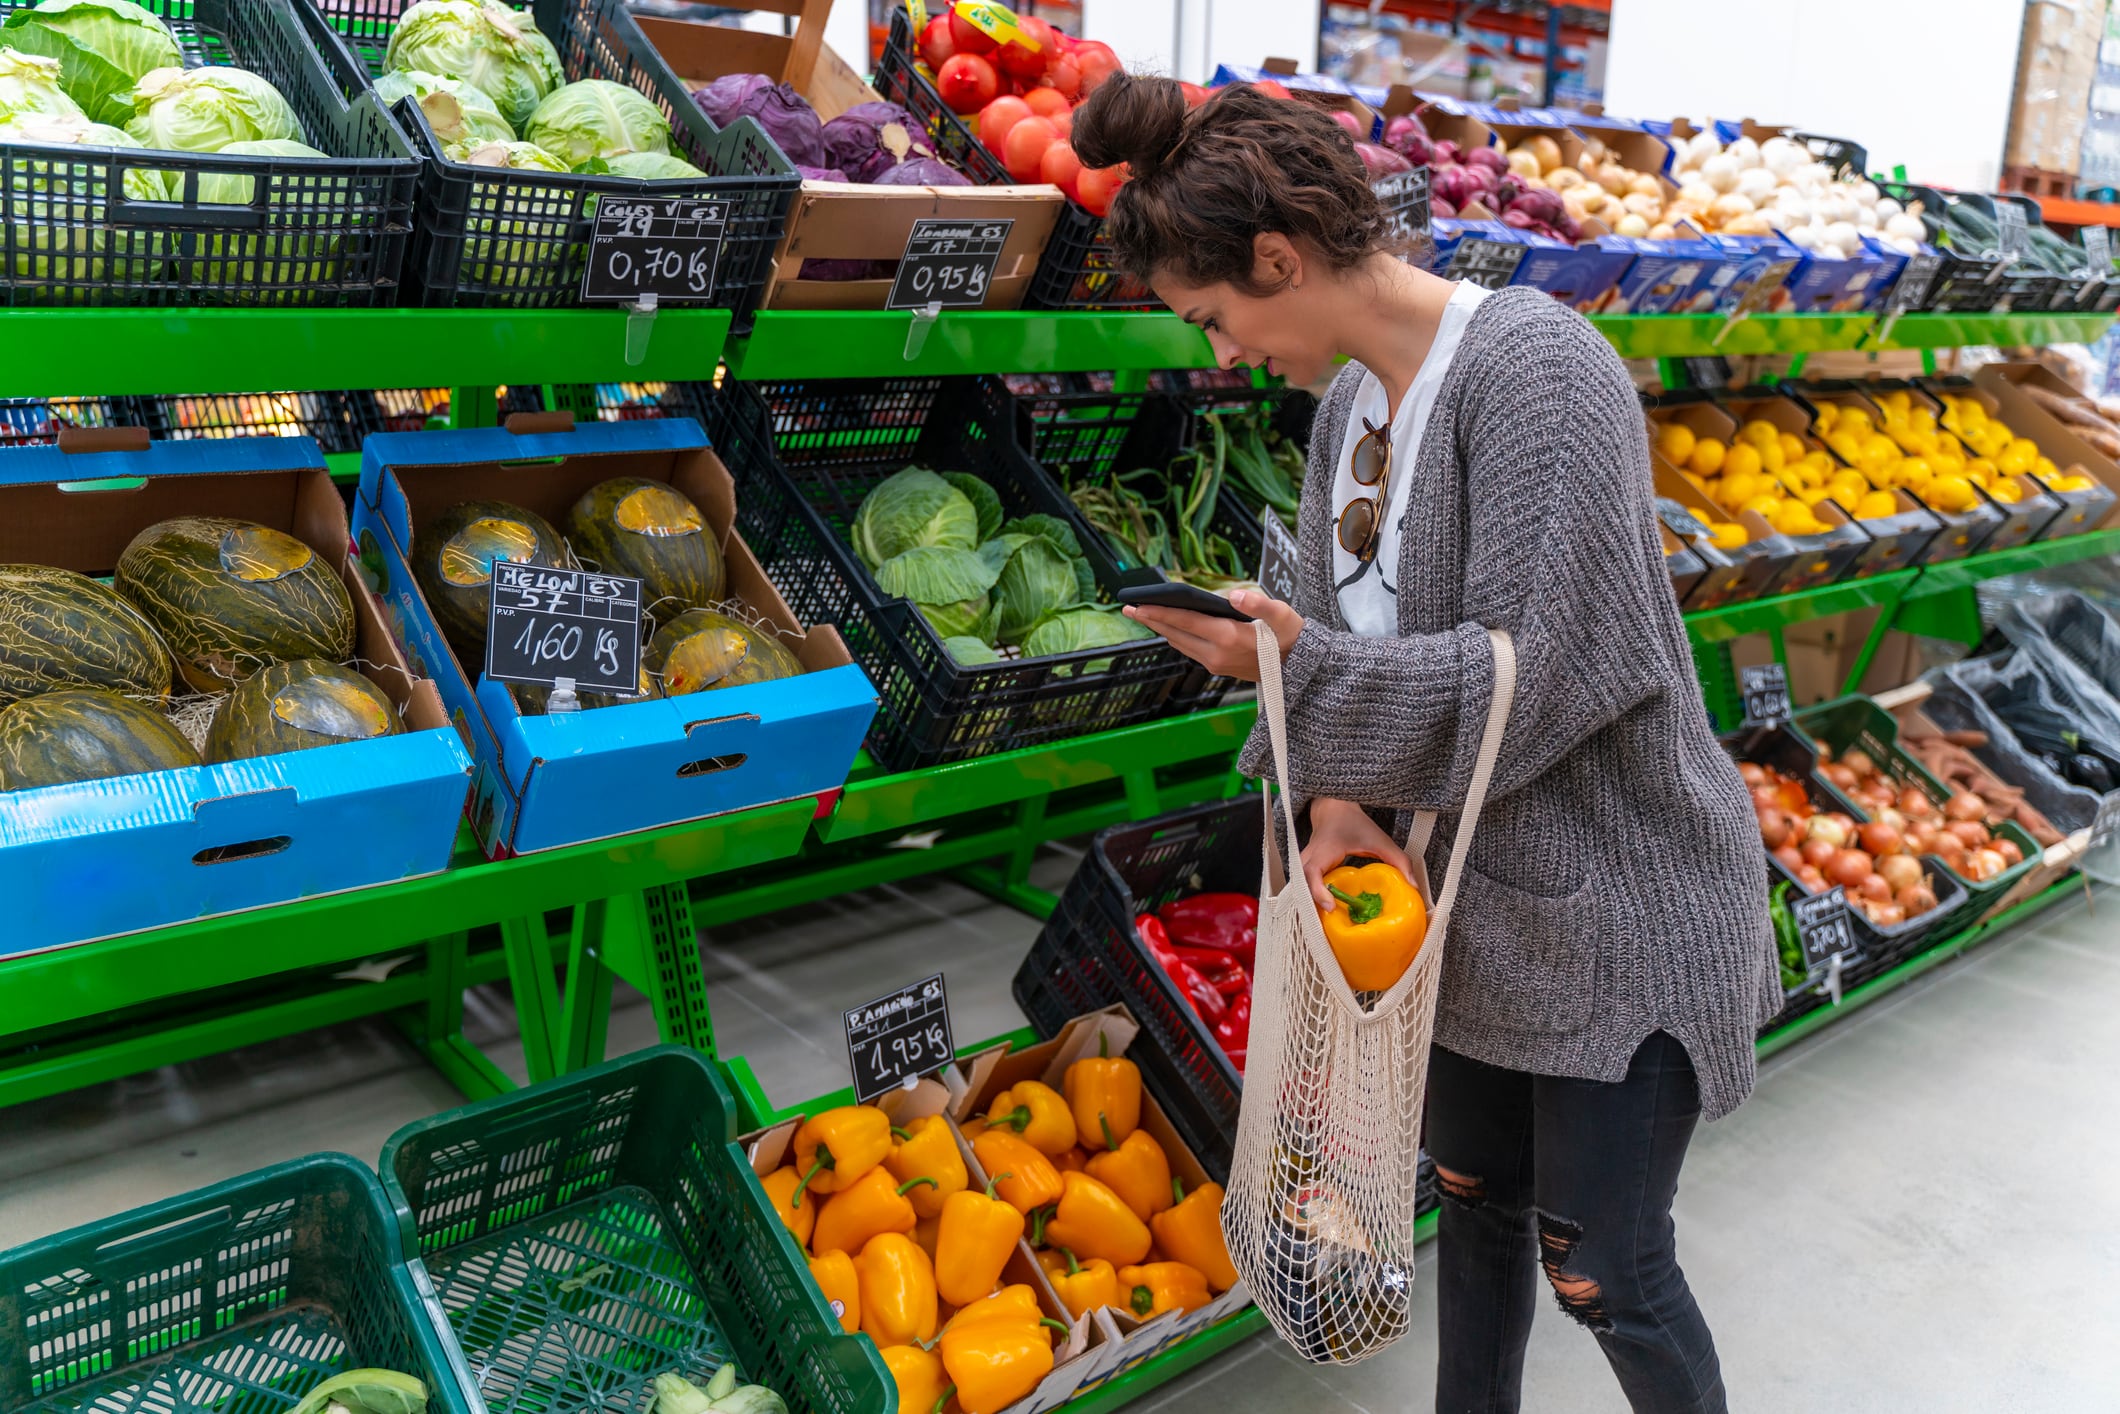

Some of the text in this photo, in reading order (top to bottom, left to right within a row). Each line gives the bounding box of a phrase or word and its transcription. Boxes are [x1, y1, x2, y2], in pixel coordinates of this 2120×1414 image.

[691, 206, 720, 221] ES
[981, 226, 1002, 239] ES
[929, 240, 957, 254] 17
[608, 247, 684, 287] 0,70
[912, 266, 969, 298] 0,95
[498, 586, 521, 594] VARIEDAD
[502, 569, 578, 592] MELON
[589, 579, 625, 599] ES
[497, 608, 516, 616] P.V.P.
[517, 589, 569, 614] 57
[513, 617, 584, 666] 1,60
[871, 1031, 923, 1080] 1,95
